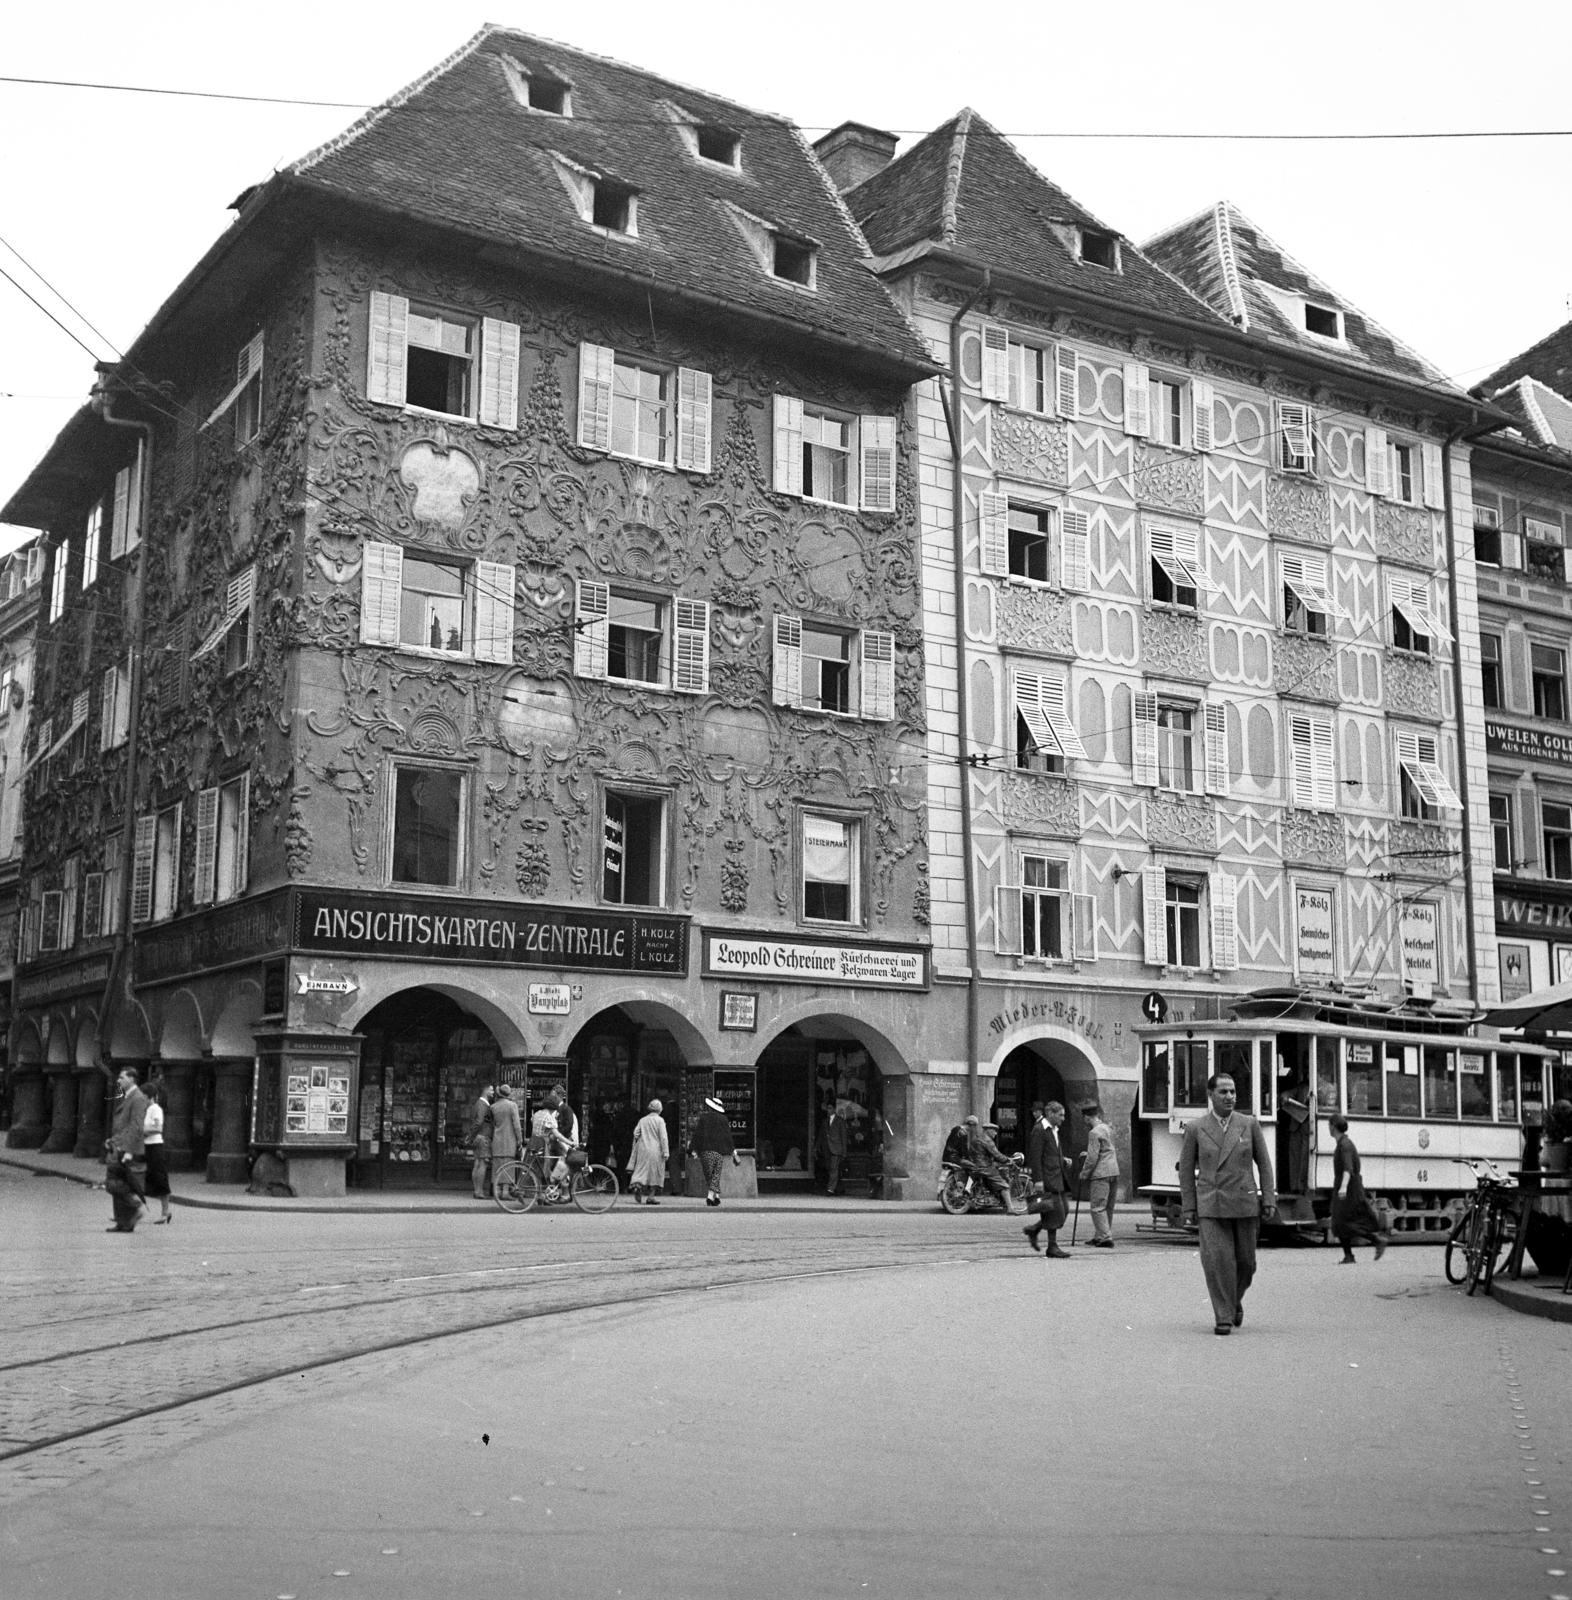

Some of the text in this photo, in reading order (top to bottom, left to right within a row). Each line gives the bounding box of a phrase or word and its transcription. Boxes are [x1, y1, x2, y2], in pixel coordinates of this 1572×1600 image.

[1502, 742, 1519, 752] AUS
[1522, 745, 1559, 760] EIGENER
[314, 907, 625, 957] ANSICHTSKARTEN-ZENTRALE
[717, 943, 836, 971] Leopold Schreiner
[840, 951, 917, 968] Kürschnerei und
[840, 963, 917, 982] Pelzwaren-Lager
[306, 981, 348, 991] EINBAHN
[1148, 995, 1160, 1018] 4
[1417, 1169, 1429, 1183] 48
